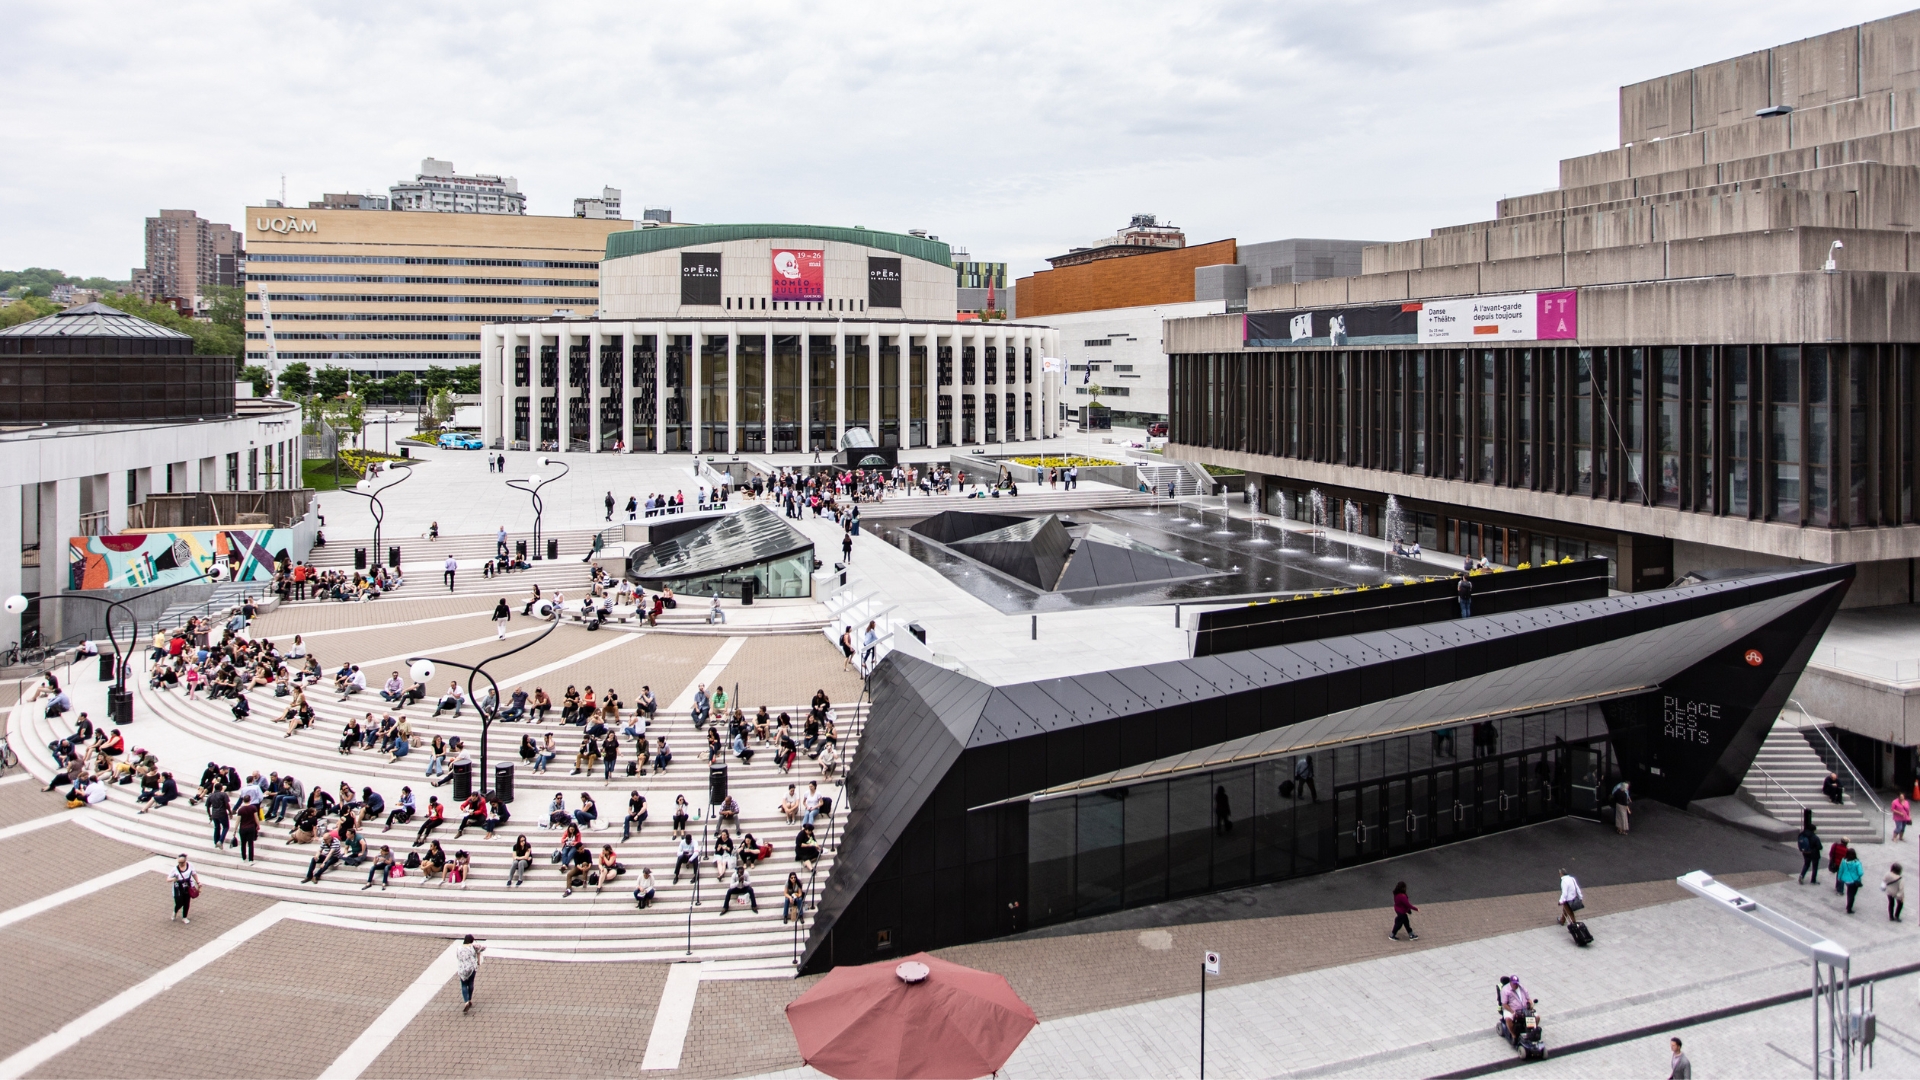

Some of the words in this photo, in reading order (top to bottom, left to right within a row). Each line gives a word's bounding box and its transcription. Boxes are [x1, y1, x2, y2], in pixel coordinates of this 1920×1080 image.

[256, 215, 318, 235] UQÀM
[1428, 308, 1446, 316] Danse
[1473, 303, 1479, 312] À
[1480, 302, 1522, 312] l'avant-garde
[1473, 312, 1494, 321] depuis
[1495, 311, 1523, 320] toujours
[1664, 695, 1721, 719] PLACE
[1664, 709, 1698, 728] DES
[1664, 723, 1709, 744] ARTS
